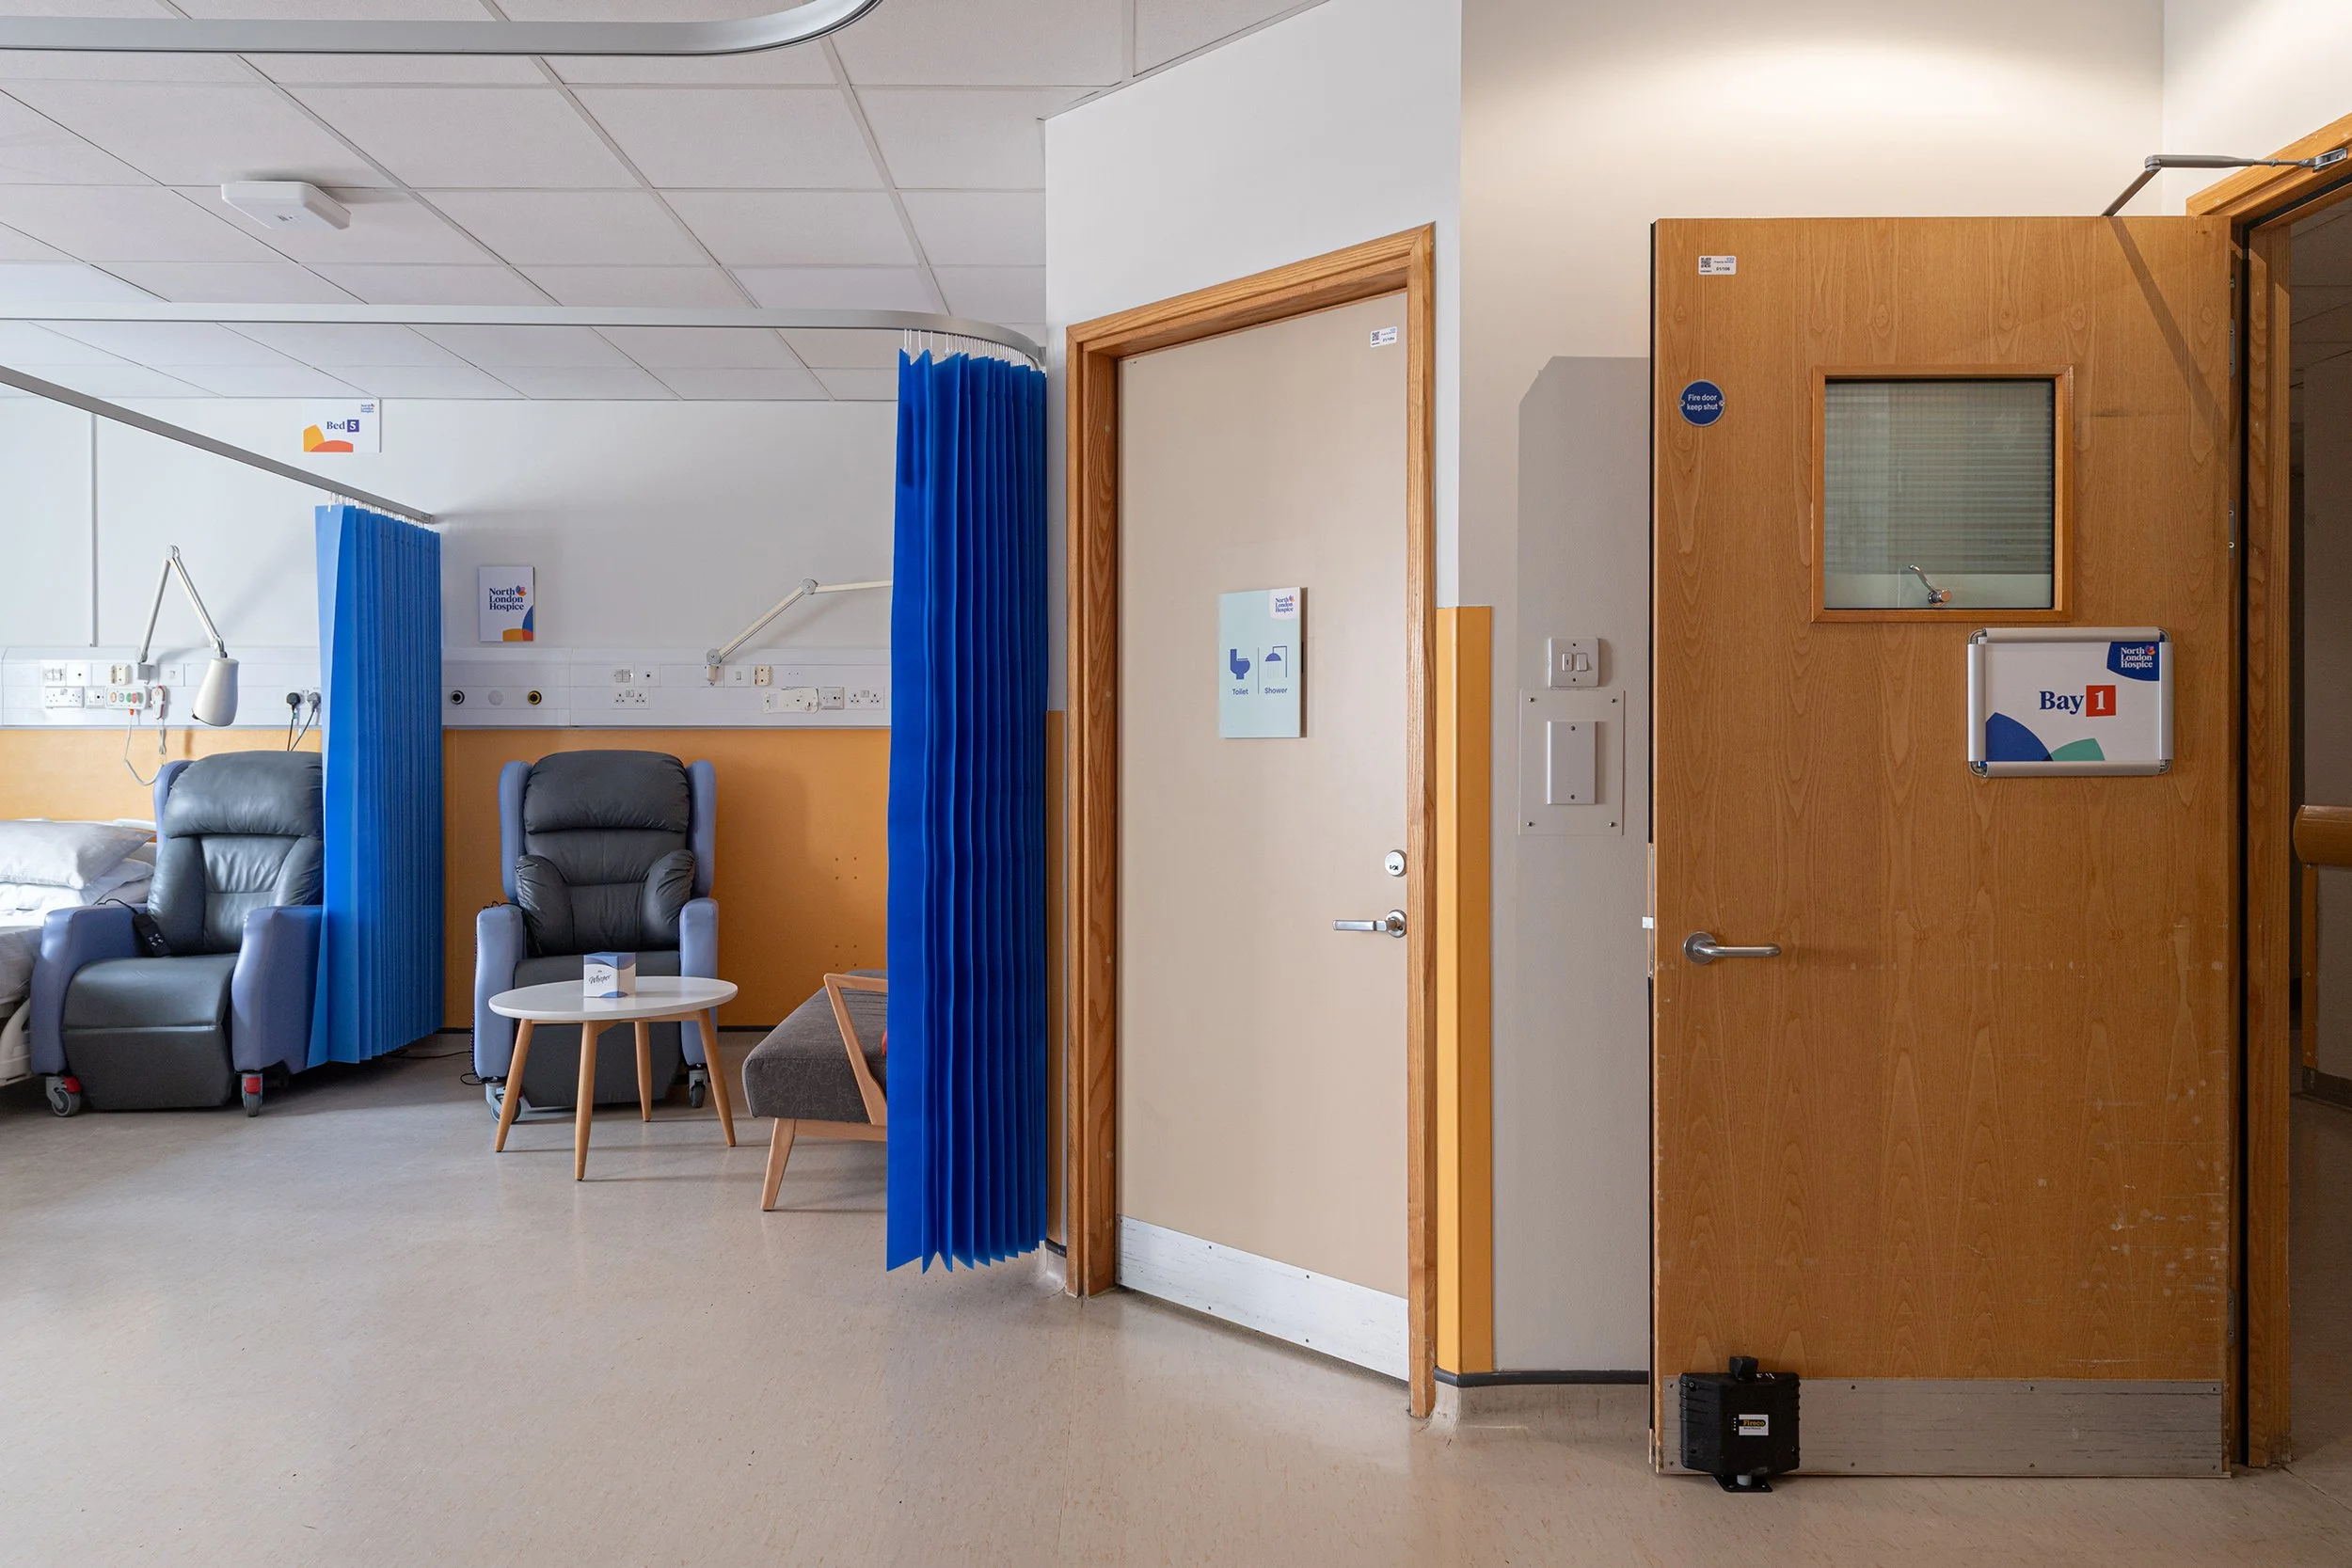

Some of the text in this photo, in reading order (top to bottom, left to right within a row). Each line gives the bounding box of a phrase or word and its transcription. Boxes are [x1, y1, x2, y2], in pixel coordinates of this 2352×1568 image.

[326, 421, 356, 430] Bed 5
[489, 603, 524, 611] Hospice
[2121, 660, 2153, 670] Hospice
[2040, 690, 2106, 715] Bay 1
